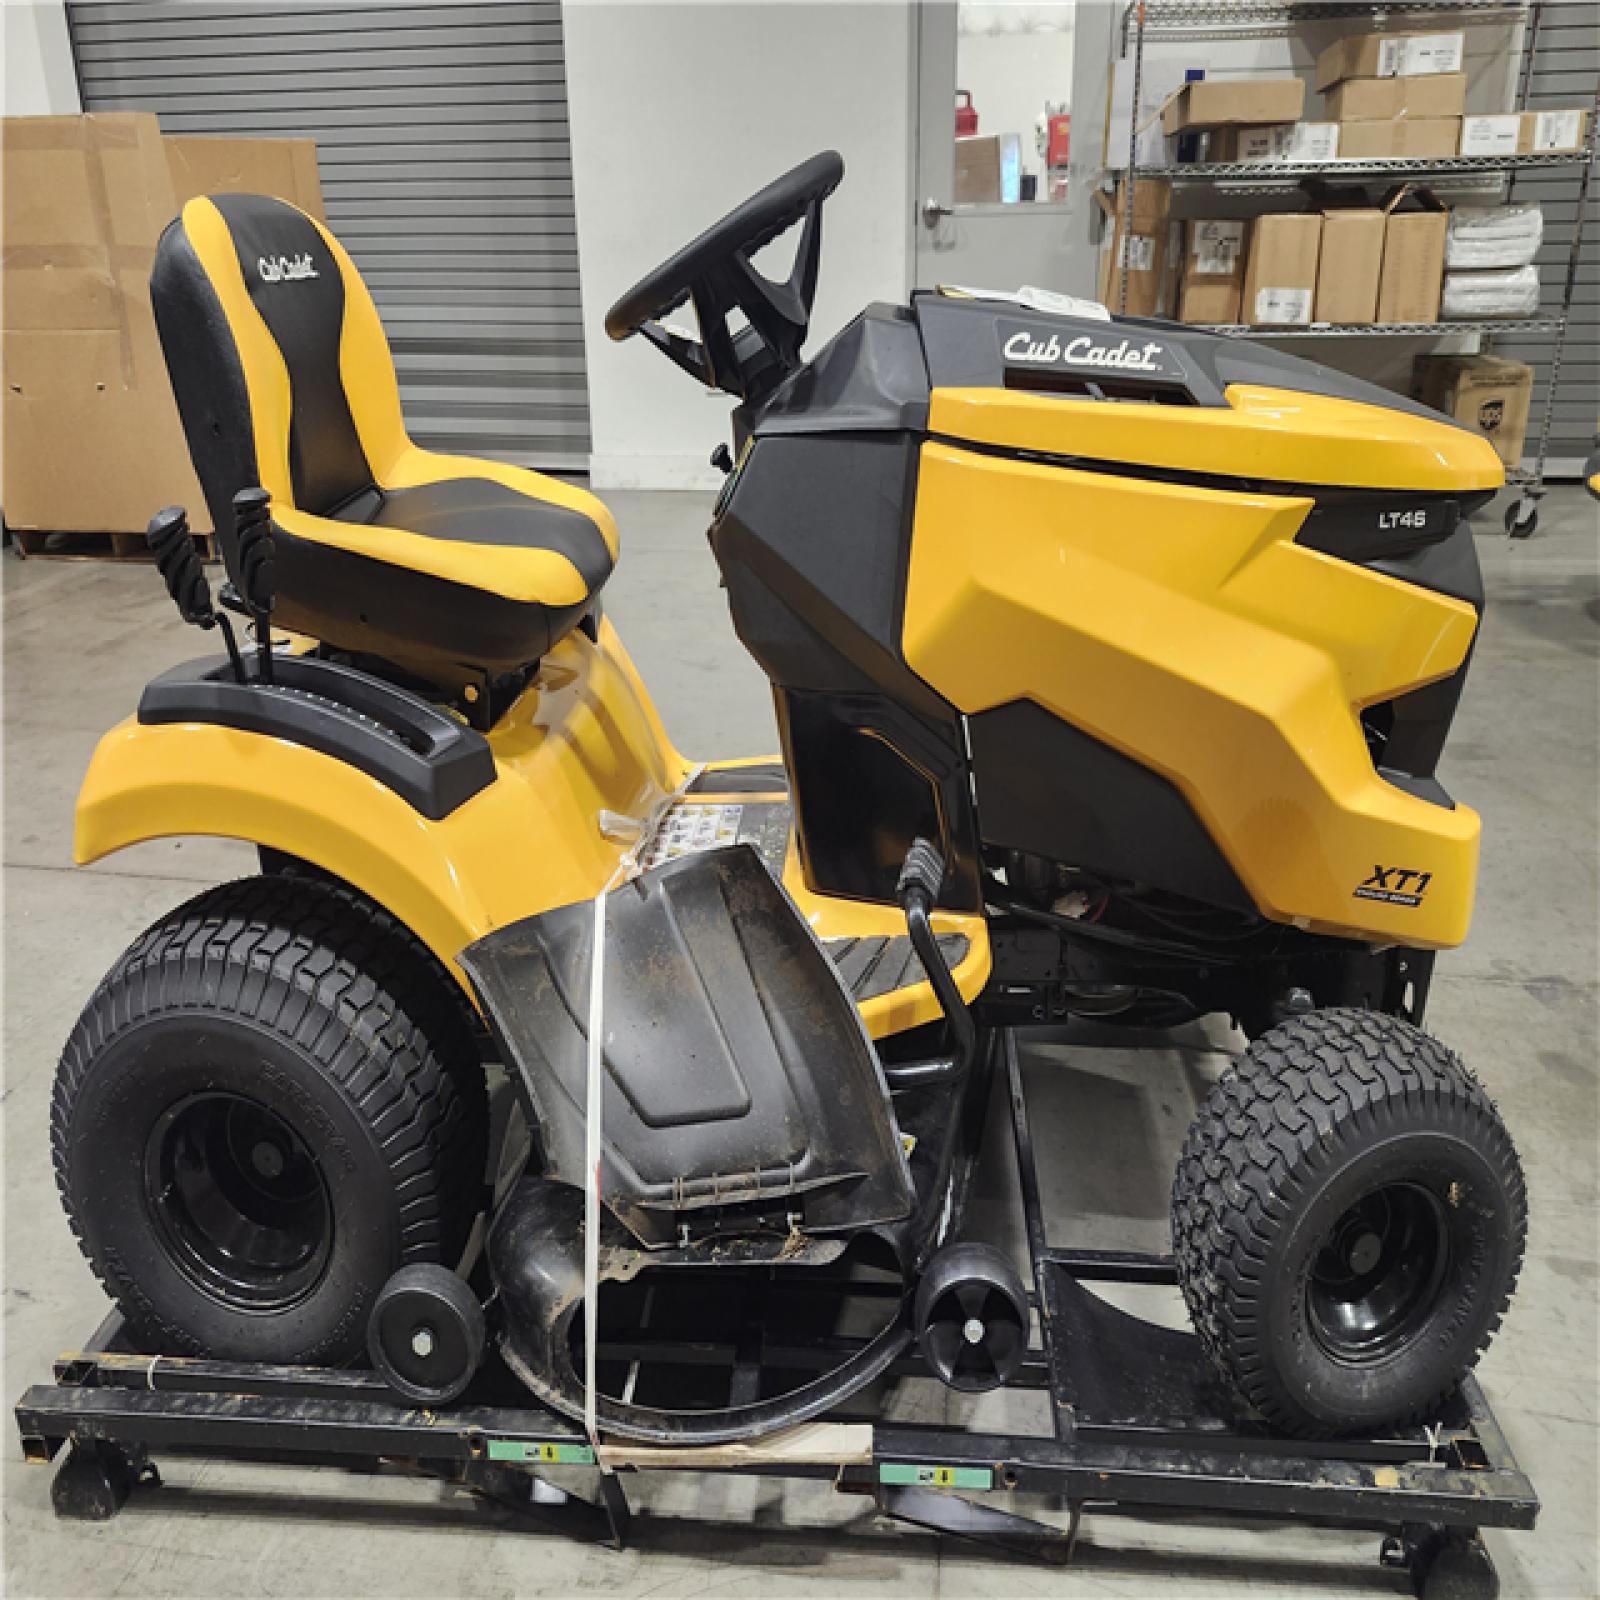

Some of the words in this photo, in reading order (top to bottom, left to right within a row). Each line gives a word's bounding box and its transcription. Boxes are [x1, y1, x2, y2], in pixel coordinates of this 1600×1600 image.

[1004, 332, 1061, 362] Cub
[1064, 337, 1163, 371] Cadet
[1379, 510, 1426, 529] LT46
[1362, 864, 1432, 894] XT1
